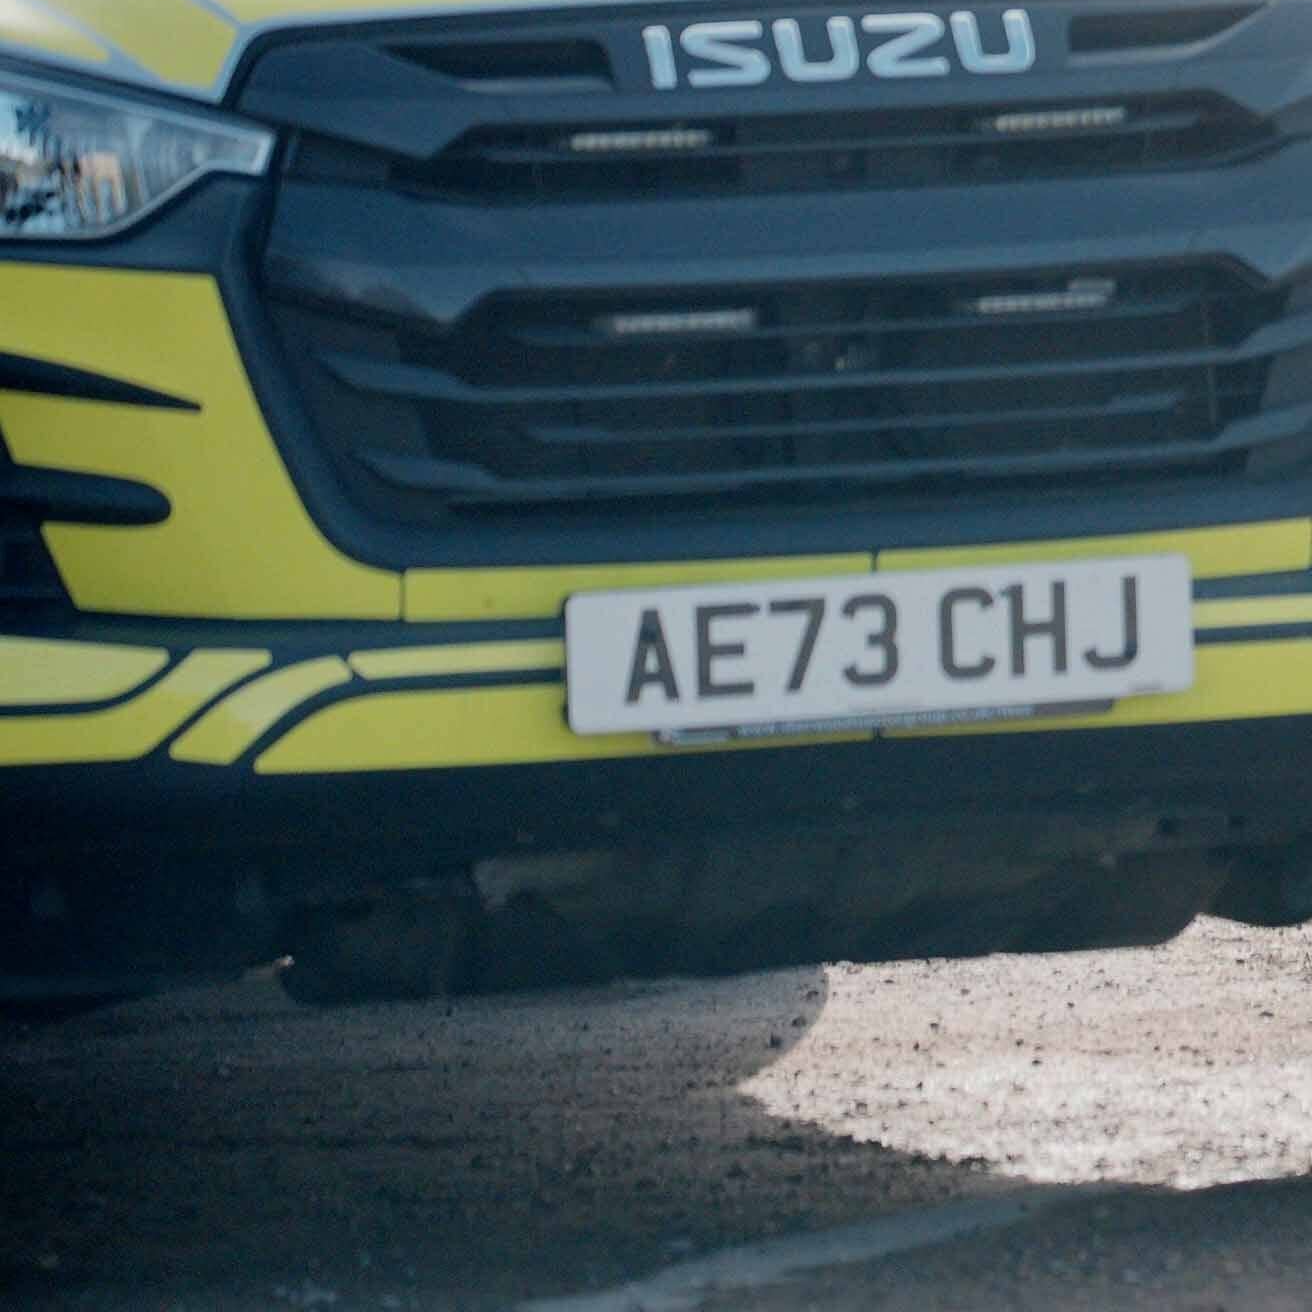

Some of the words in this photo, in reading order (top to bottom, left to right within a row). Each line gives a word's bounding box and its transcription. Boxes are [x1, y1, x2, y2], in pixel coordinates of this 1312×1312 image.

[641, 8, 1036, 90] ISUZU
[624, 592, 899, 706] AE73
[937, 575, 1140, 681] CHJ
